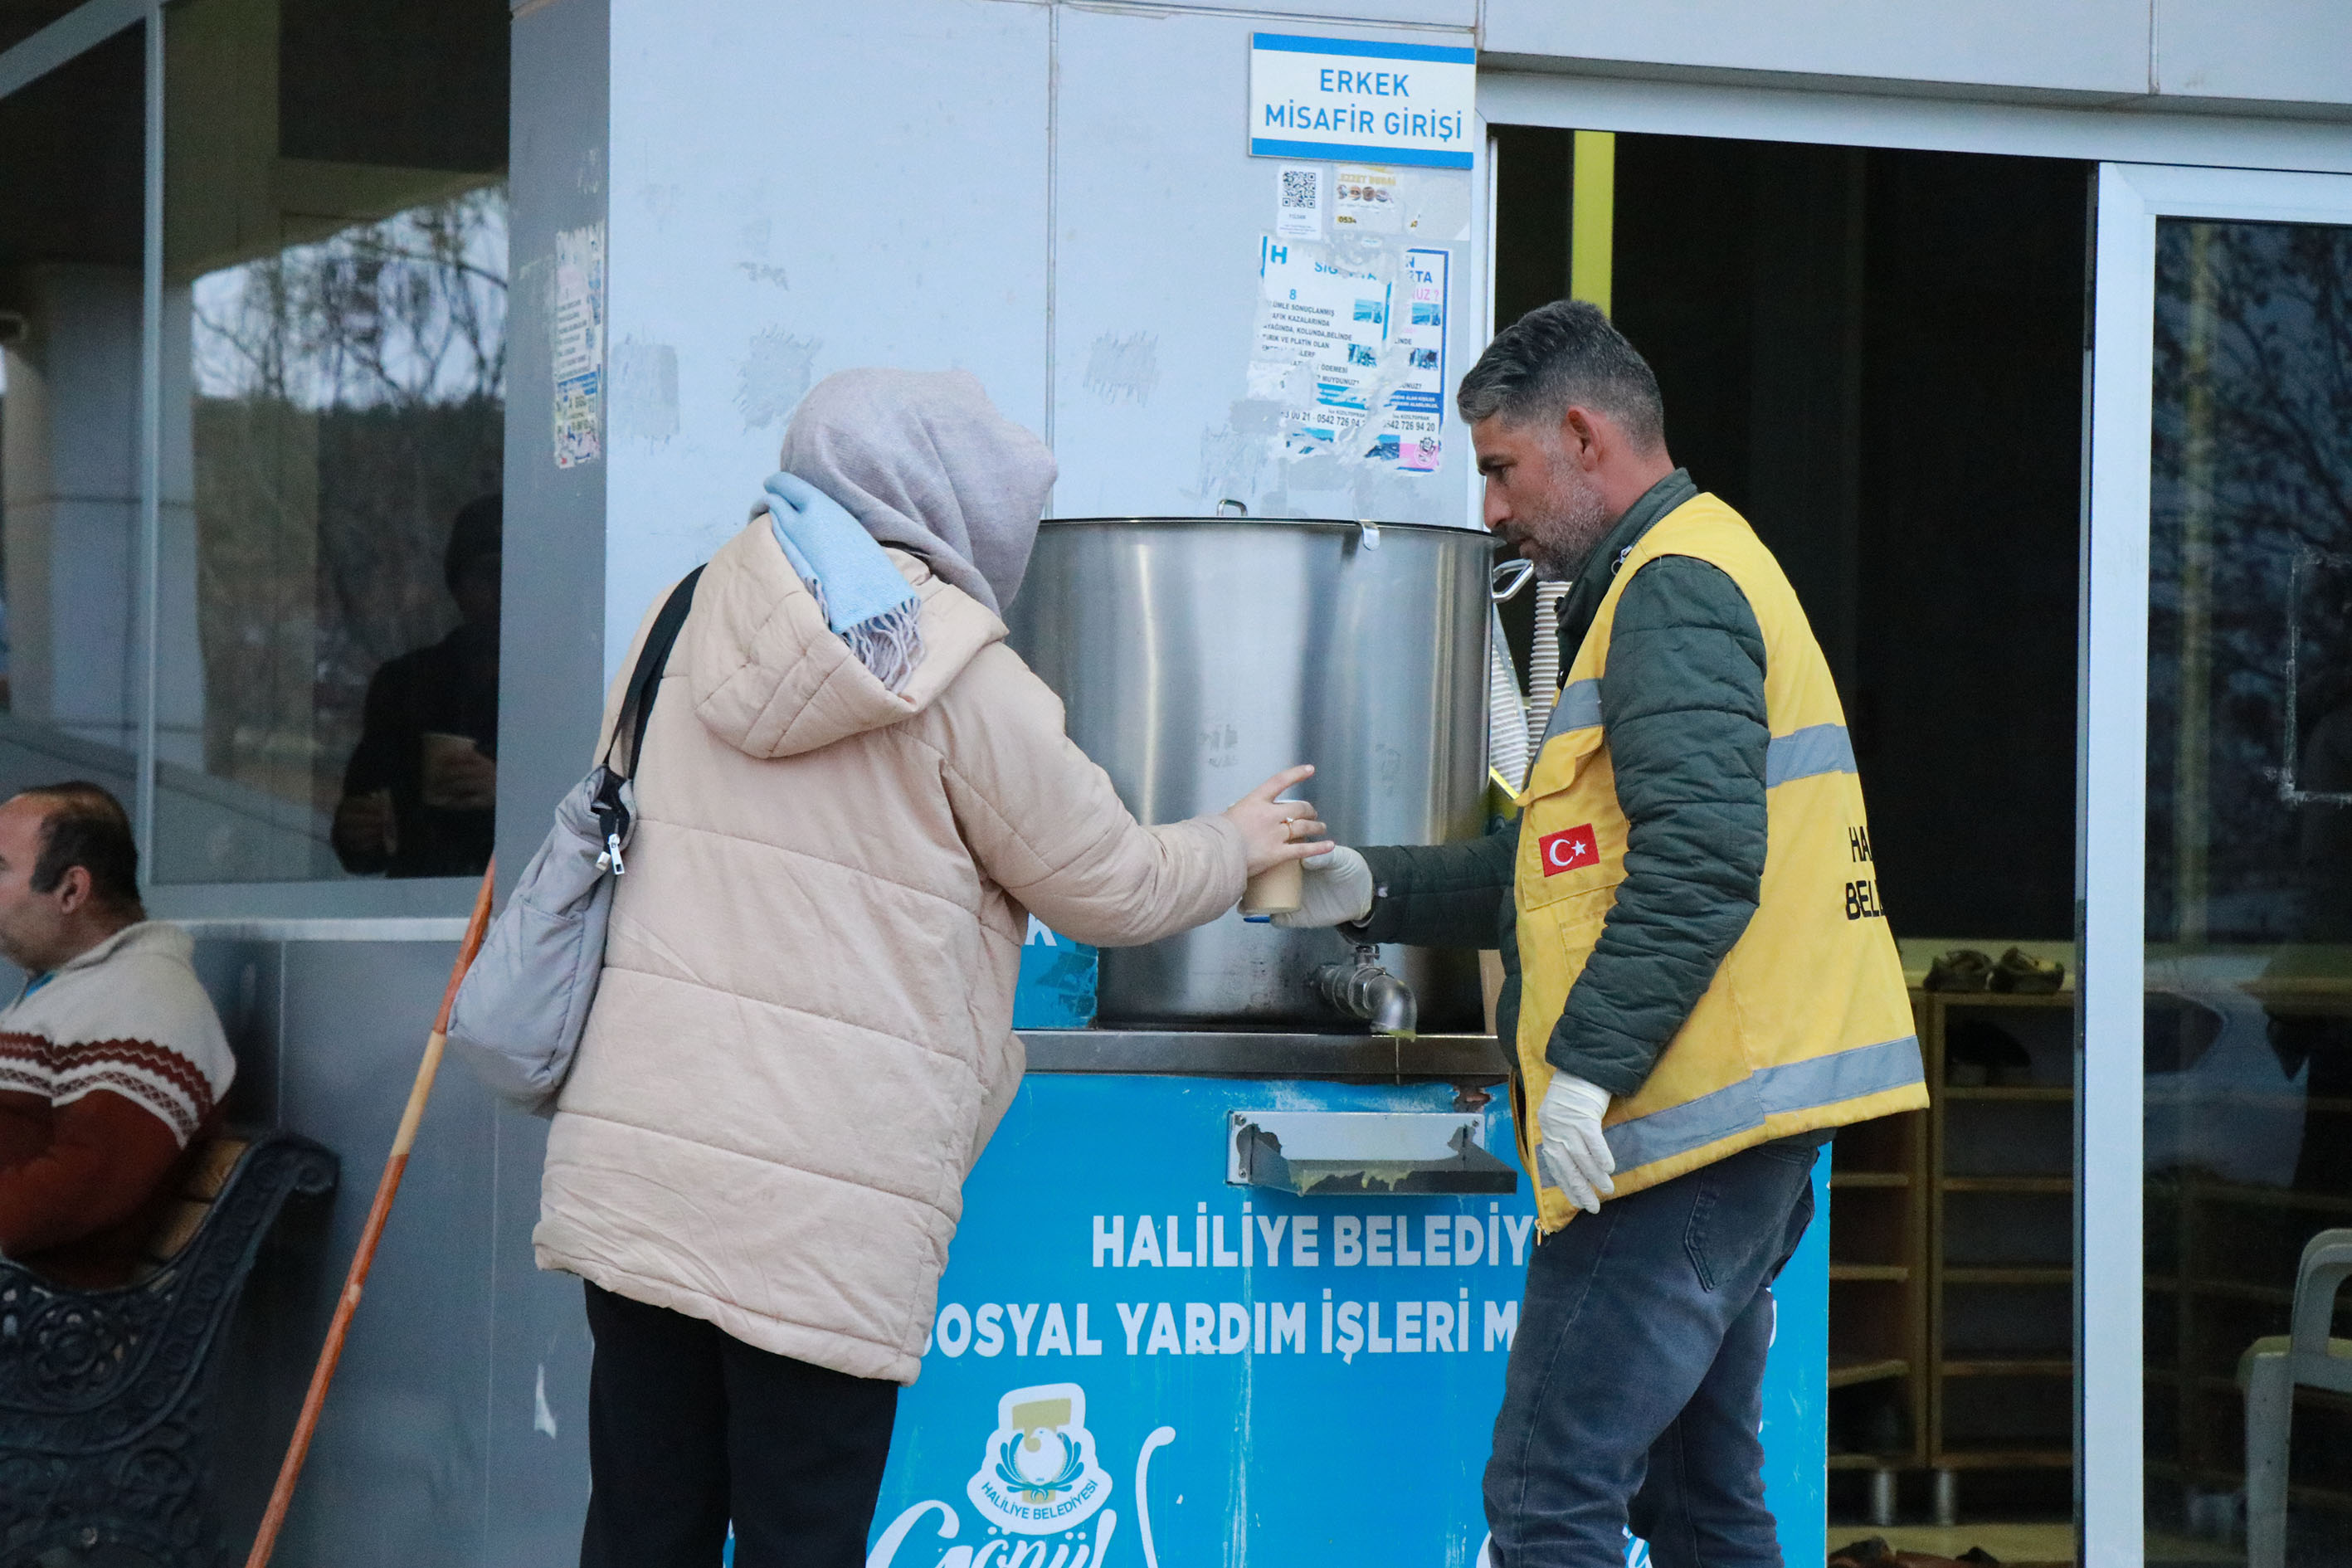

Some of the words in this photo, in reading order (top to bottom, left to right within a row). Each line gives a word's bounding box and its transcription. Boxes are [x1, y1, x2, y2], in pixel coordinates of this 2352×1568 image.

[1320, 68, 1410, 97] ERKEK
[1265, 99, 1375, 134] MİSAFİR
[1384, 106, 1462, 143] GİRİŞİ
[1289, 289, 1297, 300] 8
[1317, 413, 1334, 425] 0542
[1336, 416, 1349, 426] 726
[1401, 420, 1415, 431] 726
[1415, 421, 1424, 431] 94
[1426, 421, 1435, 432] 20
[1092, 1200, 1320, 1268] HALİLİYE
[1334, 1200, 1535, 1267] BELEDİY
[922, 1302, 1103, 1359] OSYAL
[1116, 1301, 1307, 1356] YARDIM
[1322, 1288, 1470, 1365] İŞLERİ
[981, 1481, 1030, 1520] HALİLİYE
[1032, 1478, 1099, 1521] BELEDİYESİ
